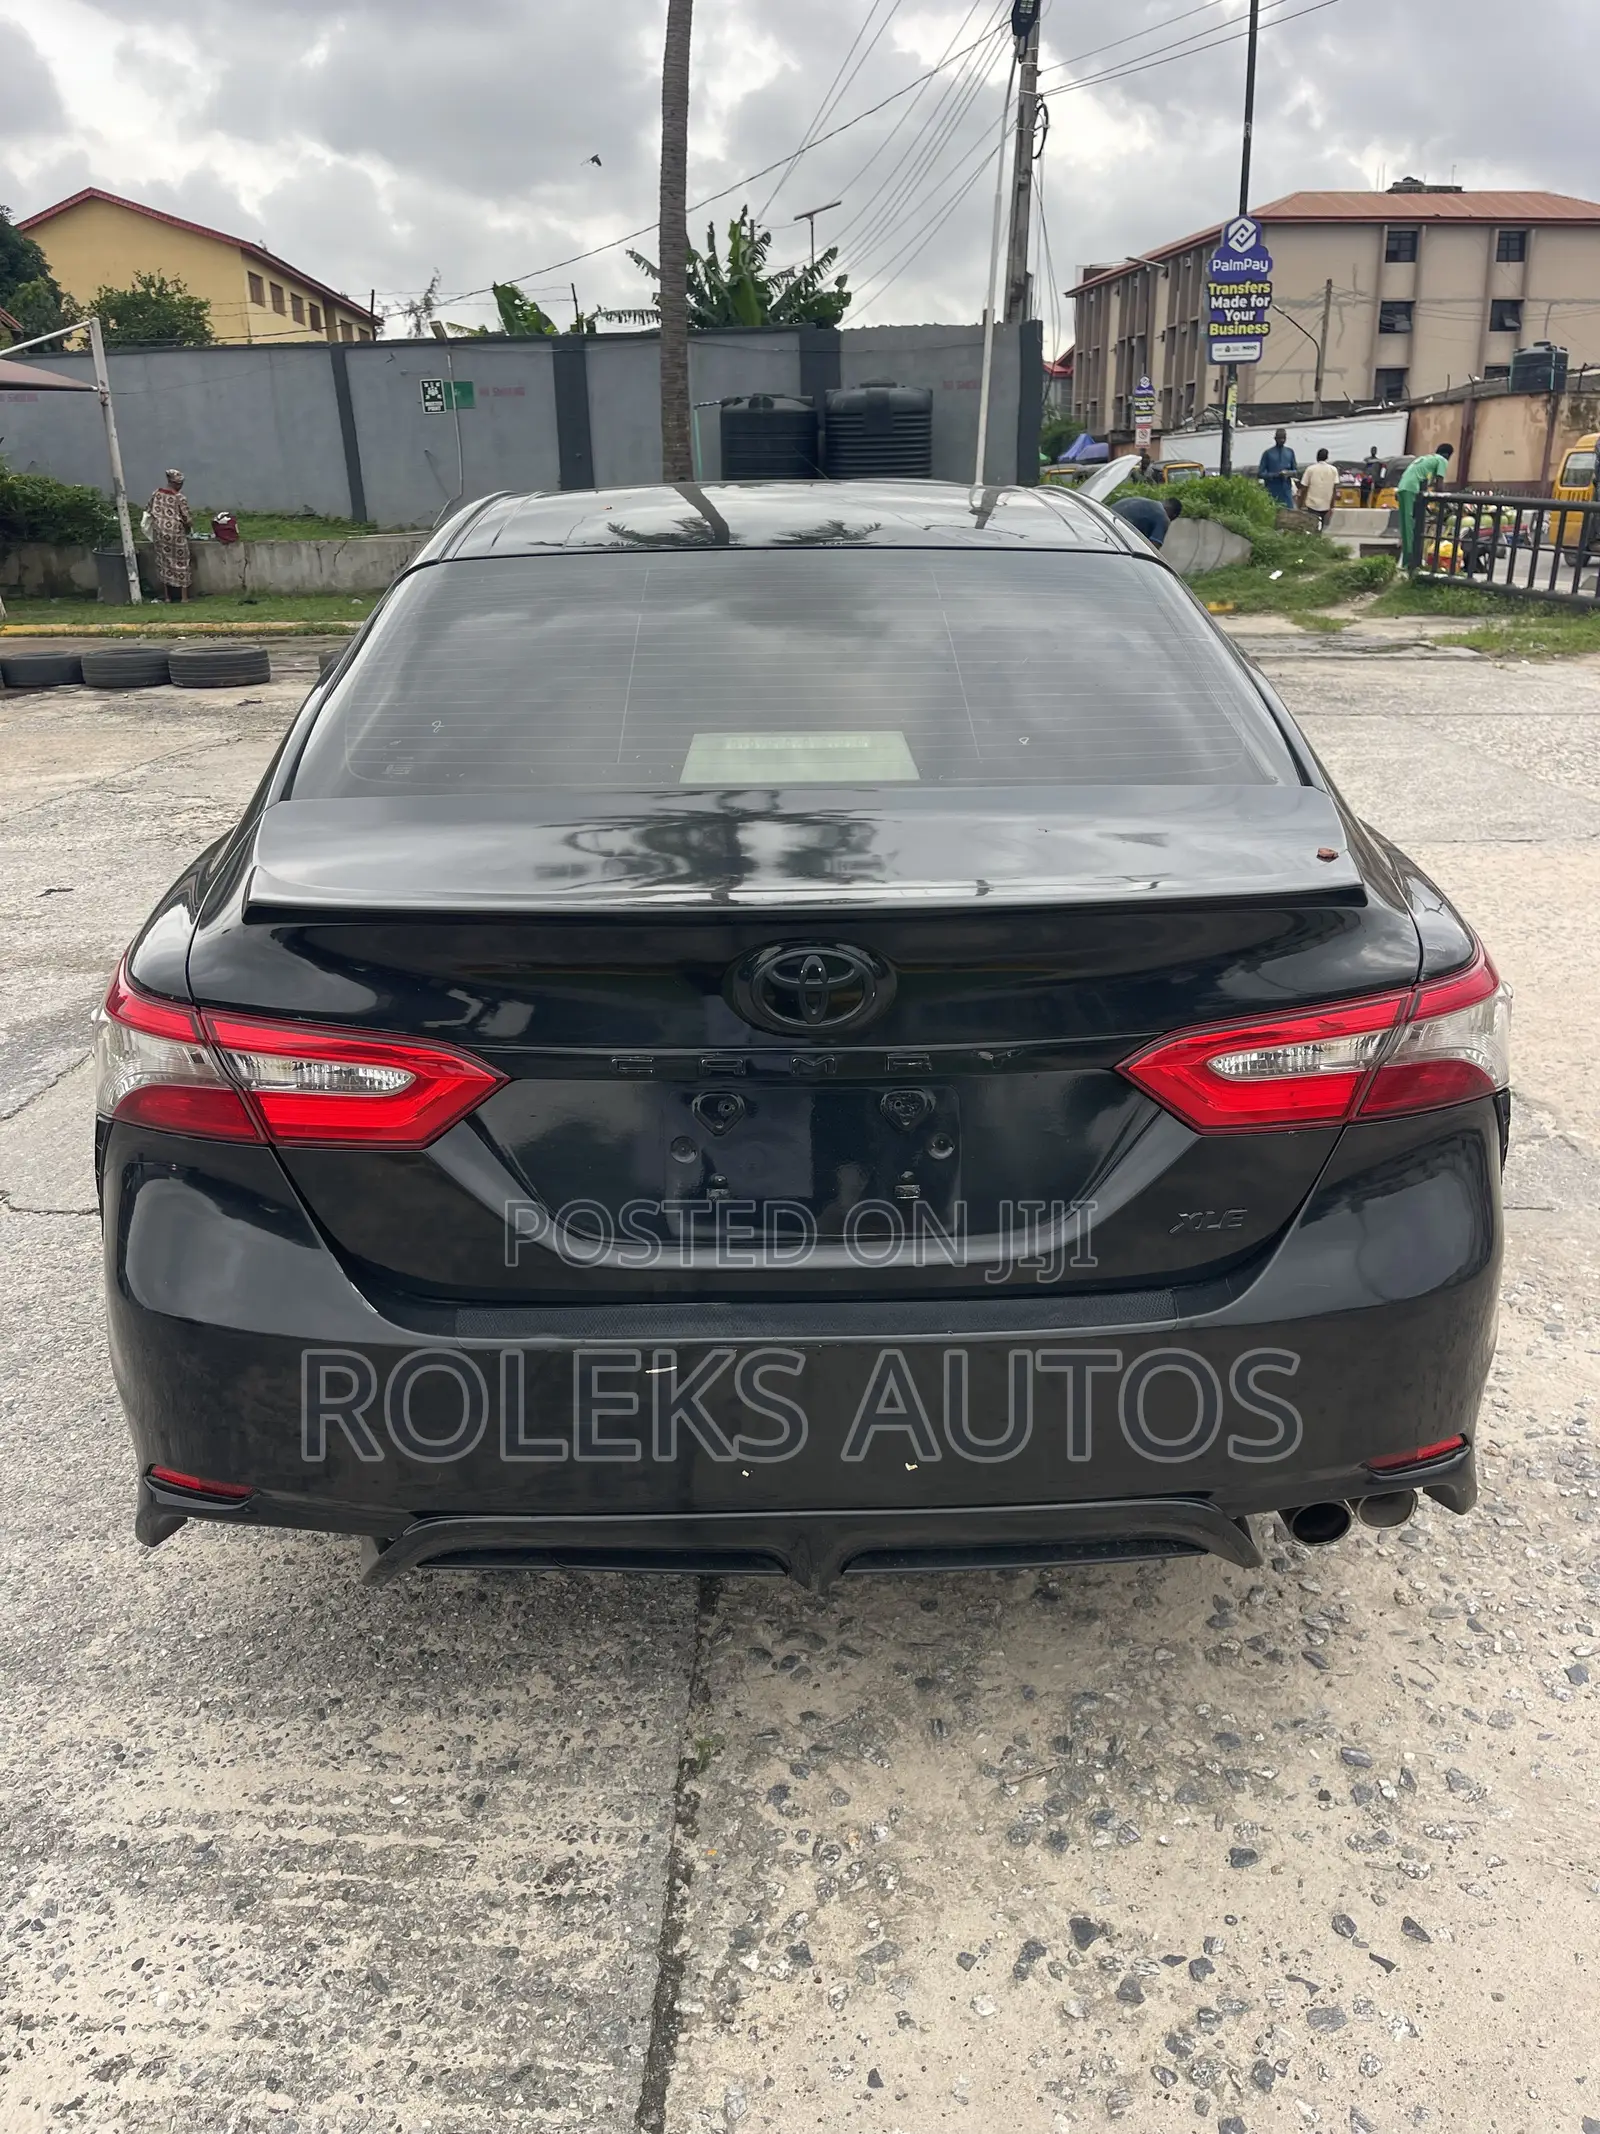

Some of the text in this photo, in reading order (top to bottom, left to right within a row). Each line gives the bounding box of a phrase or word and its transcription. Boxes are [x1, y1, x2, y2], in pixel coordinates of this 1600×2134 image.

[1212, 258, 1269, 272] PalmPay
[1208, 281, 1271, 295] Transfers
[1210, 294, 1271, 309] Made for
[1224, 309, 1256, 321] Your
[1209, 321, 1269, 336] Business
[1168, 1207, 1248, 1235] XLE
